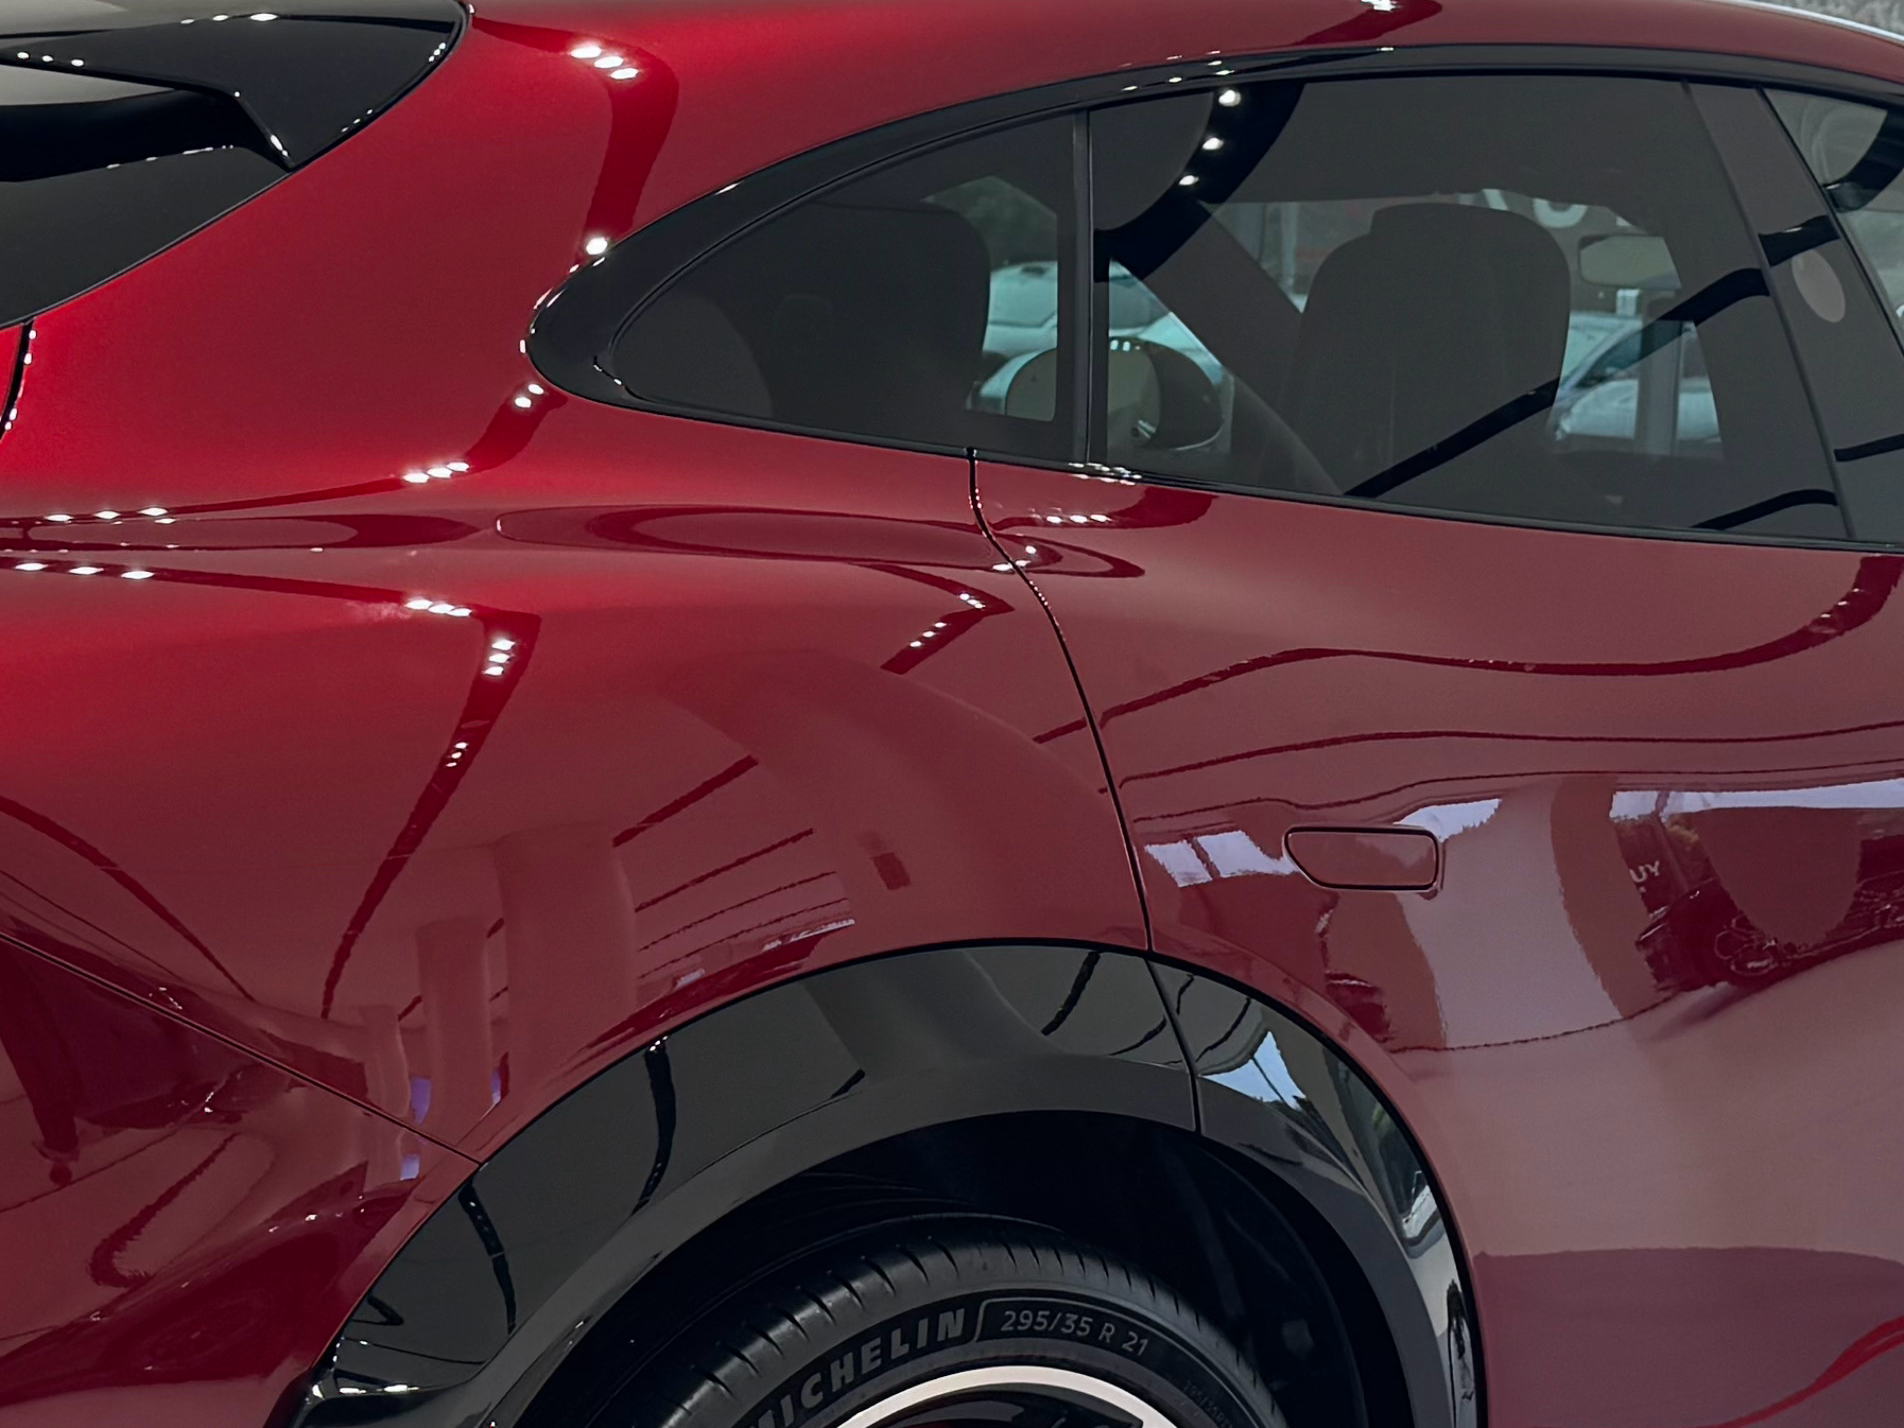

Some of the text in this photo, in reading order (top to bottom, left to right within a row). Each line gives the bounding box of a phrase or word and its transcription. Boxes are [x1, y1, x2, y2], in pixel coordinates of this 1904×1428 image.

[1000, 1310, 1094, 1340] 295/35
[1097, 1321, 1116, 1344] R
[1121, 1330, 1149, 1356] 21
